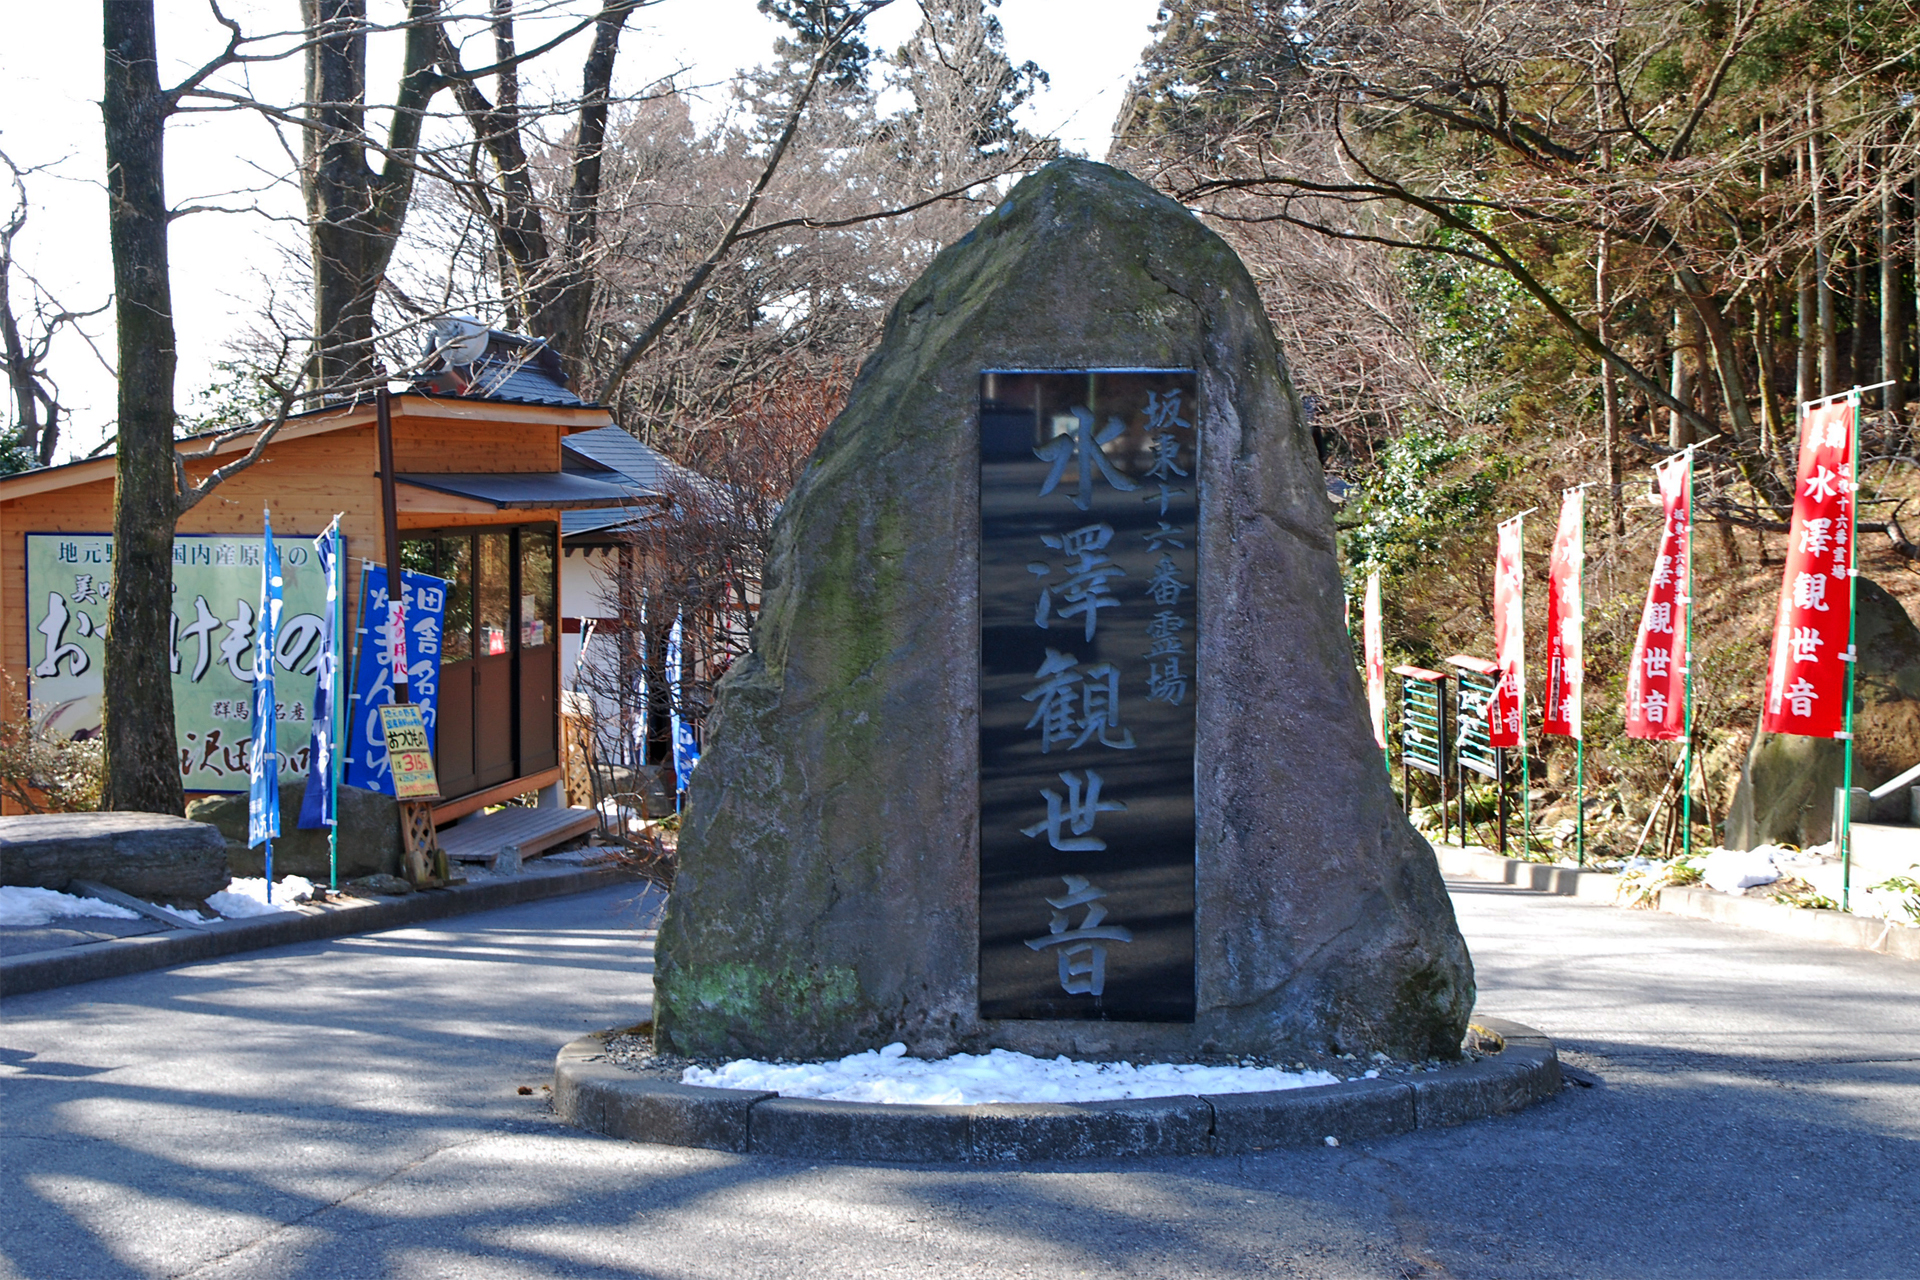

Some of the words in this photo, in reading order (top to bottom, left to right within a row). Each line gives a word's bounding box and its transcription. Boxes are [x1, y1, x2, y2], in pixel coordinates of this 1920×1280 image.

[35, 590, 327, 683] おけもの
[1142, 387, 1192, 706] 坂東十六番霊場
[1783, 464, 1837, 718] 水澤観世音
[213, 701, 306, 721] 群馬名産
[1020, 404, 1143, 996] 水澤観世音
